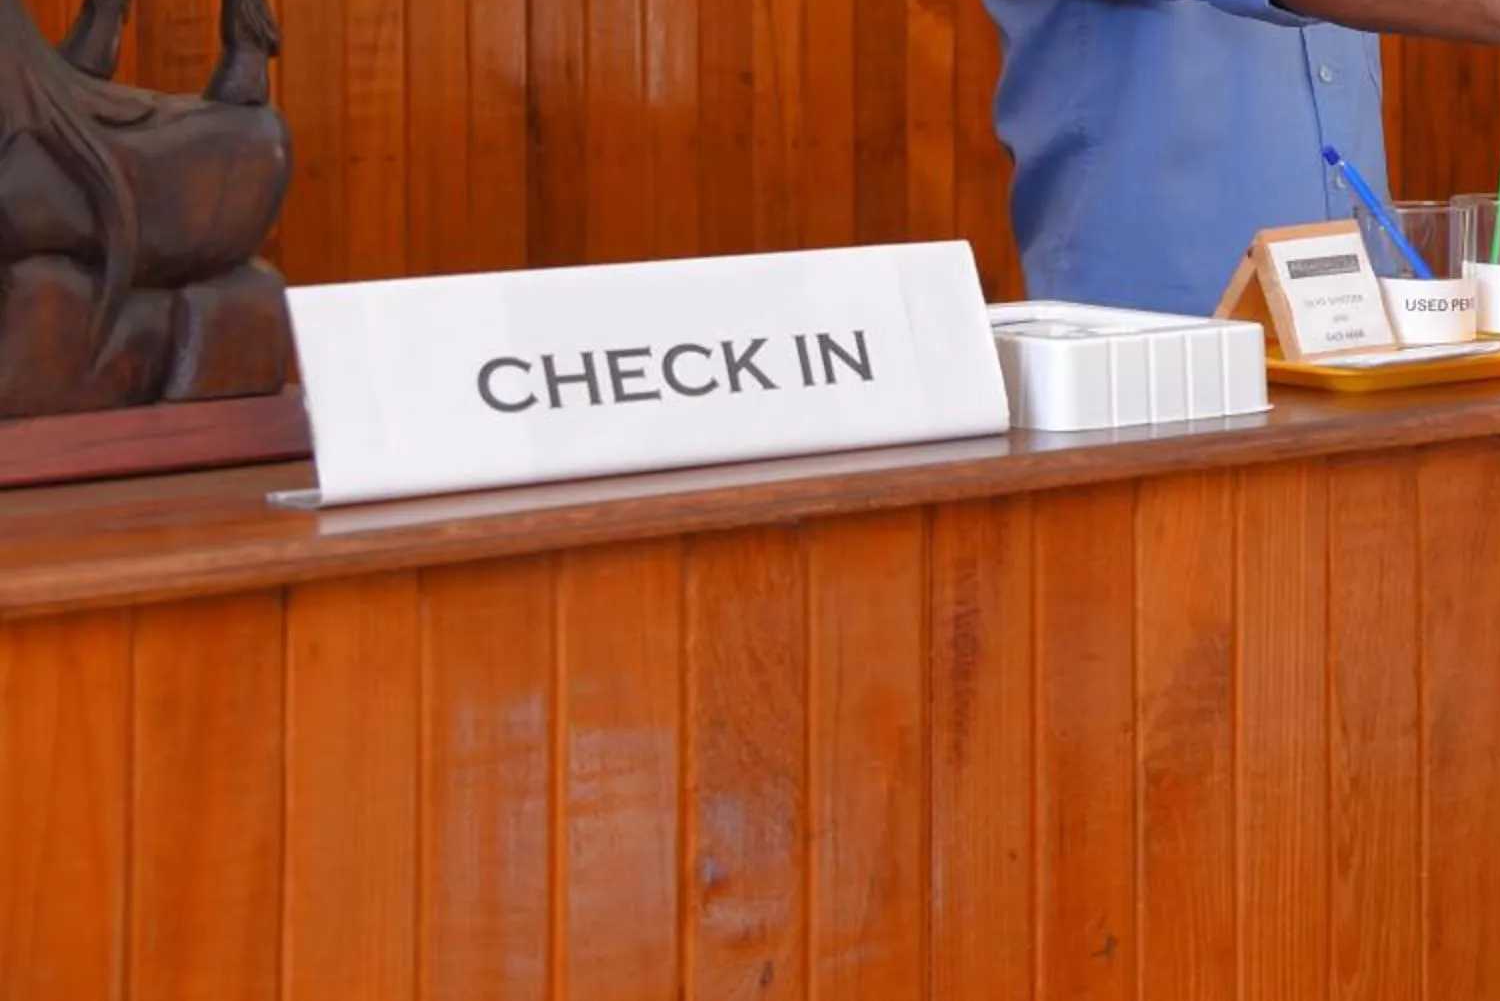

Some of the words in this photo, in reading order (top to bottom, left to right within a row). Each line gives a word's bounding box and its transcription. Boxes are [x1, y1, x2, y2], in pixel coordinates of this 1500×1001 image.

[1405, 298, 1449, 312] USED
[477, 336, 780, 414] CHECK
[792, 329, 875, 387] IN
